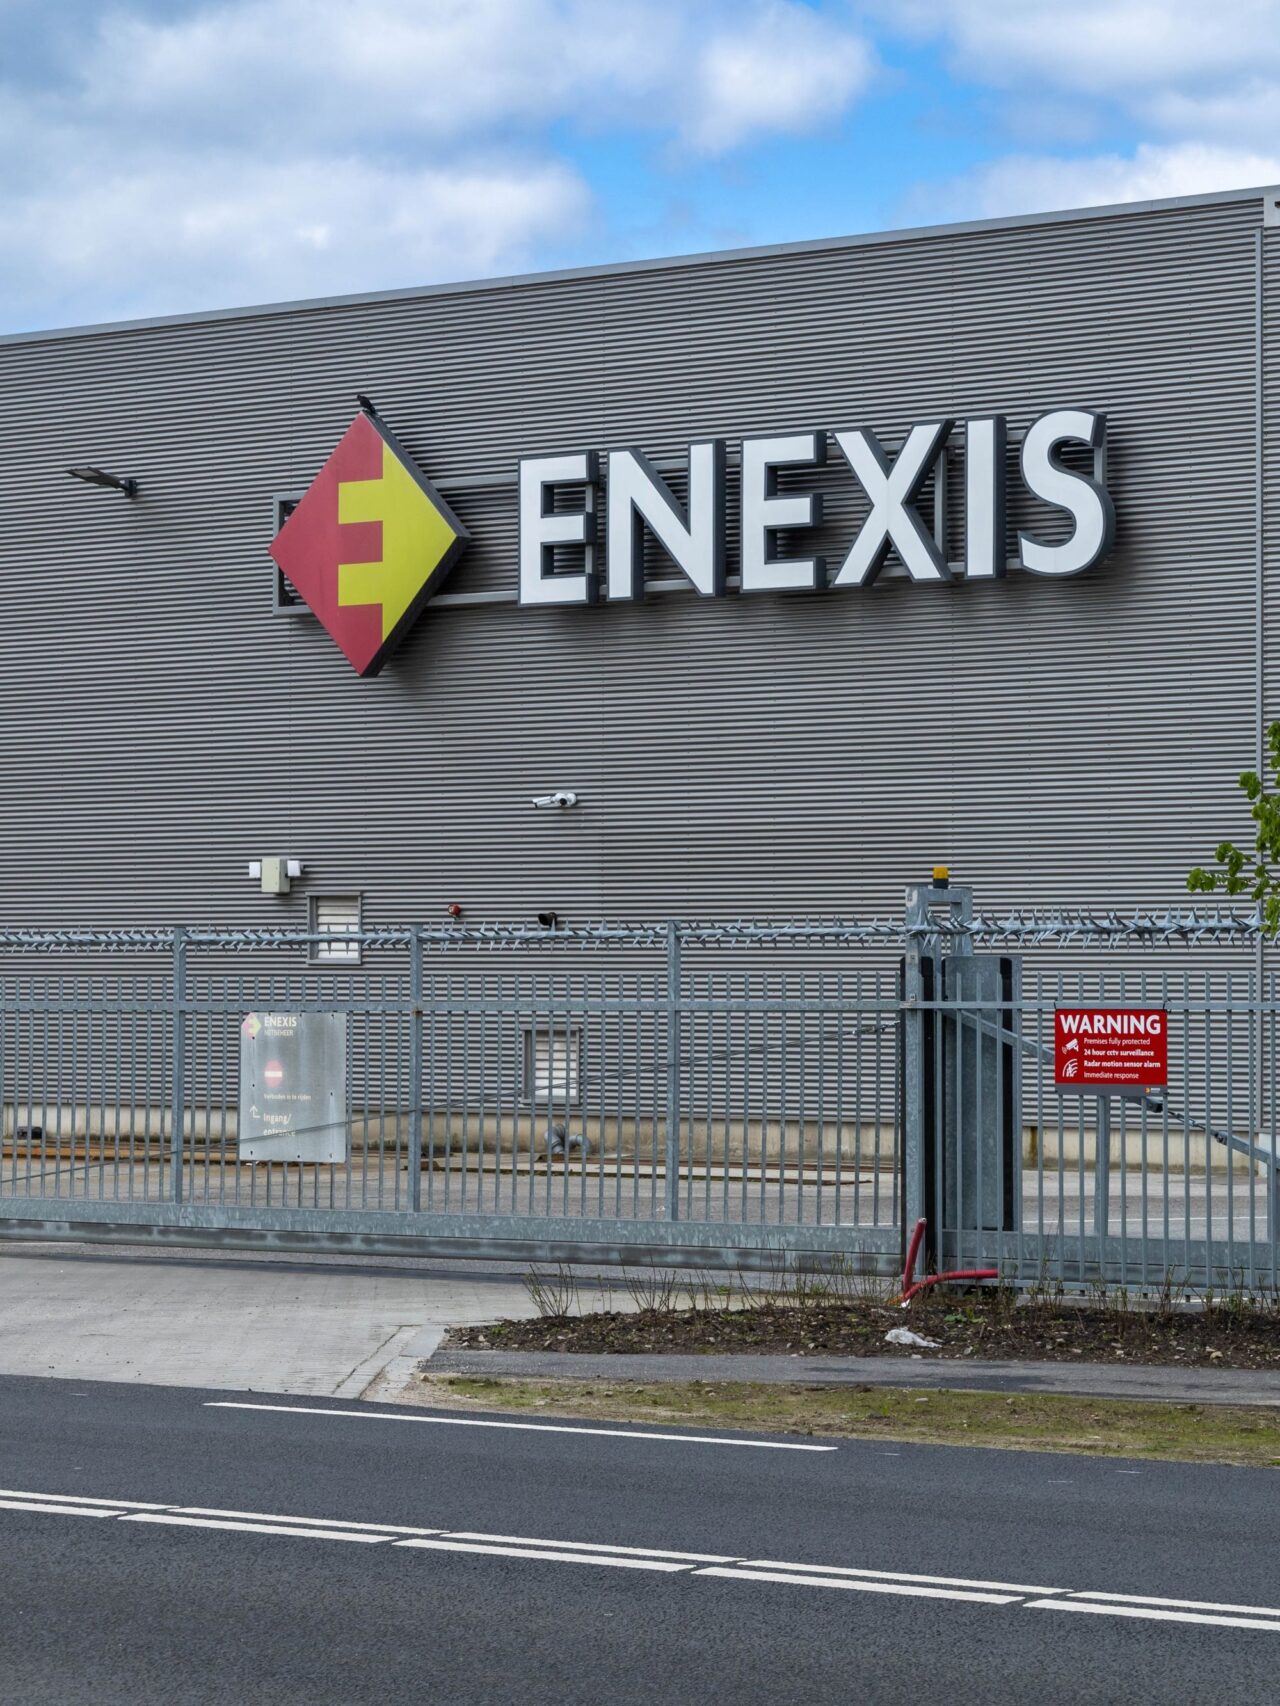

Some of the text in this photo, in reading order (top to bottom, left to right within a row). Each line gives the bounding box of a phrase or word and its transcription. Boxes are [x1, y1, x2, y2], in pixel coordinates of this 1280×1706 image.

[517, 407, 1114, 607] ENEXIS
[264, 1016, 297, 1027] ENEXIS
[1060, 1015, 1161, 1035] WARNING
[1108, 1038, 1121, 1046] fully
[1122, 1038, 1150, 1046] protected
[1143, 1060, 1161, 1068] alarm
[264, 1113, 291, 1125] Ingang/
